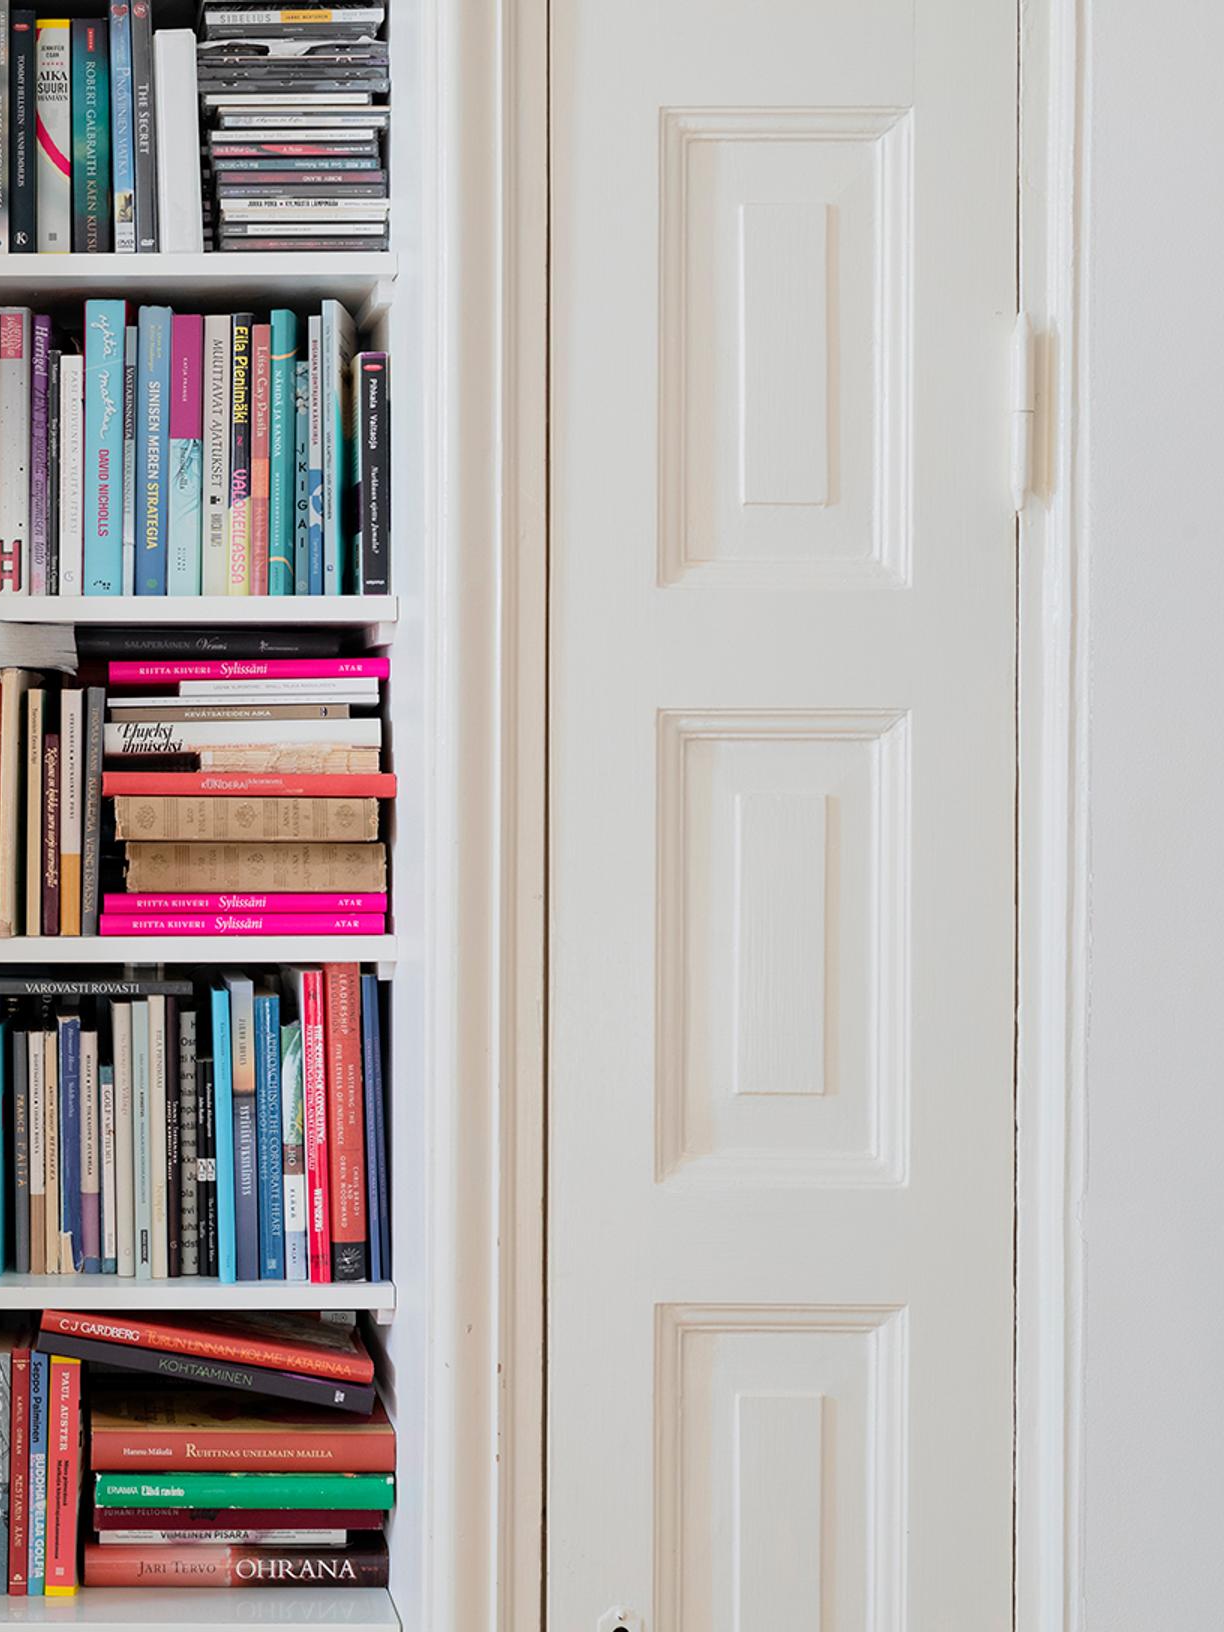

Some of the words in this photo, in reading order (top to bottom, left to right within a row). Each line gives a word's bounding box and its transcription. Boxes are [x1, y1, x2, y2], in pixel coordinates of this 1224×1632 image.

[37, 71, 67, 81] AIKA
[37, 82, 68, 94] SUURI
[86, 62, 95, 106] ROBERT
[138, 83, 150, 108] THE
[86, 110, 96, 176] GALBRAITH
[138, 111, 150, 155] SECRET
[87, 215, 97, 252] KUTSU
[33, 326, 49, 376] Herrigel
[89, 314, 117, 359] yhtä
[234, 326, 249, 352] Eila
[211, 339, 224, 415] MUUTTAVAT
[233, 355, 250, 424] Pienimäki
[274, 370, 284, 406] NÄHDÄ
[368, 378, 379, 409] Pihkala
[98, 370, 117, 439] matkaa
[148, 381, 161, 432] SINISEN
[274, 409, 283, 421] JA
[147, 435, 160, 480] MEREN
[210, 419, 223, 488] AJATUKSET
[274, 424, 283, 457] SANOA
[98, 449, 109, 480] DAVID
[98, 484, 109, 537] NICHOLLS
[146, 482, 160, 550] STRATEGIA
[232, 468, 247, 584] VALOKEILASSA
[174, 666, 211, 675] KIIVERI
[219, 662, 269, 679] Sylissäni
[338, 663, 363, 672] ATAR
[117, 721, 174, 740] Ehyeksi
[122, 738, 184, 753] ihmiseksi
[87, 777, 97, 832] KUOLEMA
[83, 836, 96, 913] VENETSIASSA
[218, 896, 267, 911] Sylissäni
[214, 917, 264, 932] Sylissäni
[25, 984, 89, 993] VAROVASTI
[92, 984, 140, 993] ROVASTI
[339, 973, 348, 1035] LEADERSHIP
[267, 1031, 279, 1110] APPROACHING
[269, 1112, 279, 1134] THE
[270, 1136, 280, 1197] CORPORATE
[271, 1198, 281, 1236] HEART
[59, 1318, 69, 1330] C
[69, 1319, 78, 1332] J
[80, 1321, 141, 1342] GARDBERG
[31, 1361, 42, 1393] Seppo
[61, 1372, 70, 1401] PAUL
[157, 1358, 254, 1386] KOHTAAMINEN
[32, 1396, 42, 1443] Palminen
[59, 1404, 70, 1451] AUSTER
[185, 1443, 241, 1459] RUHTINAS
[243, 1449, 295, 1459] UNELMAIN
[296, 1450, 333, 1459] MAILLA
[34, 1453, 46, 1500] BUDDHA
[214, 1530, 249, 1539] PISARA
[33, 1538, 45, 1578] GOLFIA
[136, 1562, 168, 1577] JARI
[171, 1563, 216, 1574] TERVO
[236, 1559, 357, 1580] OHRANA
